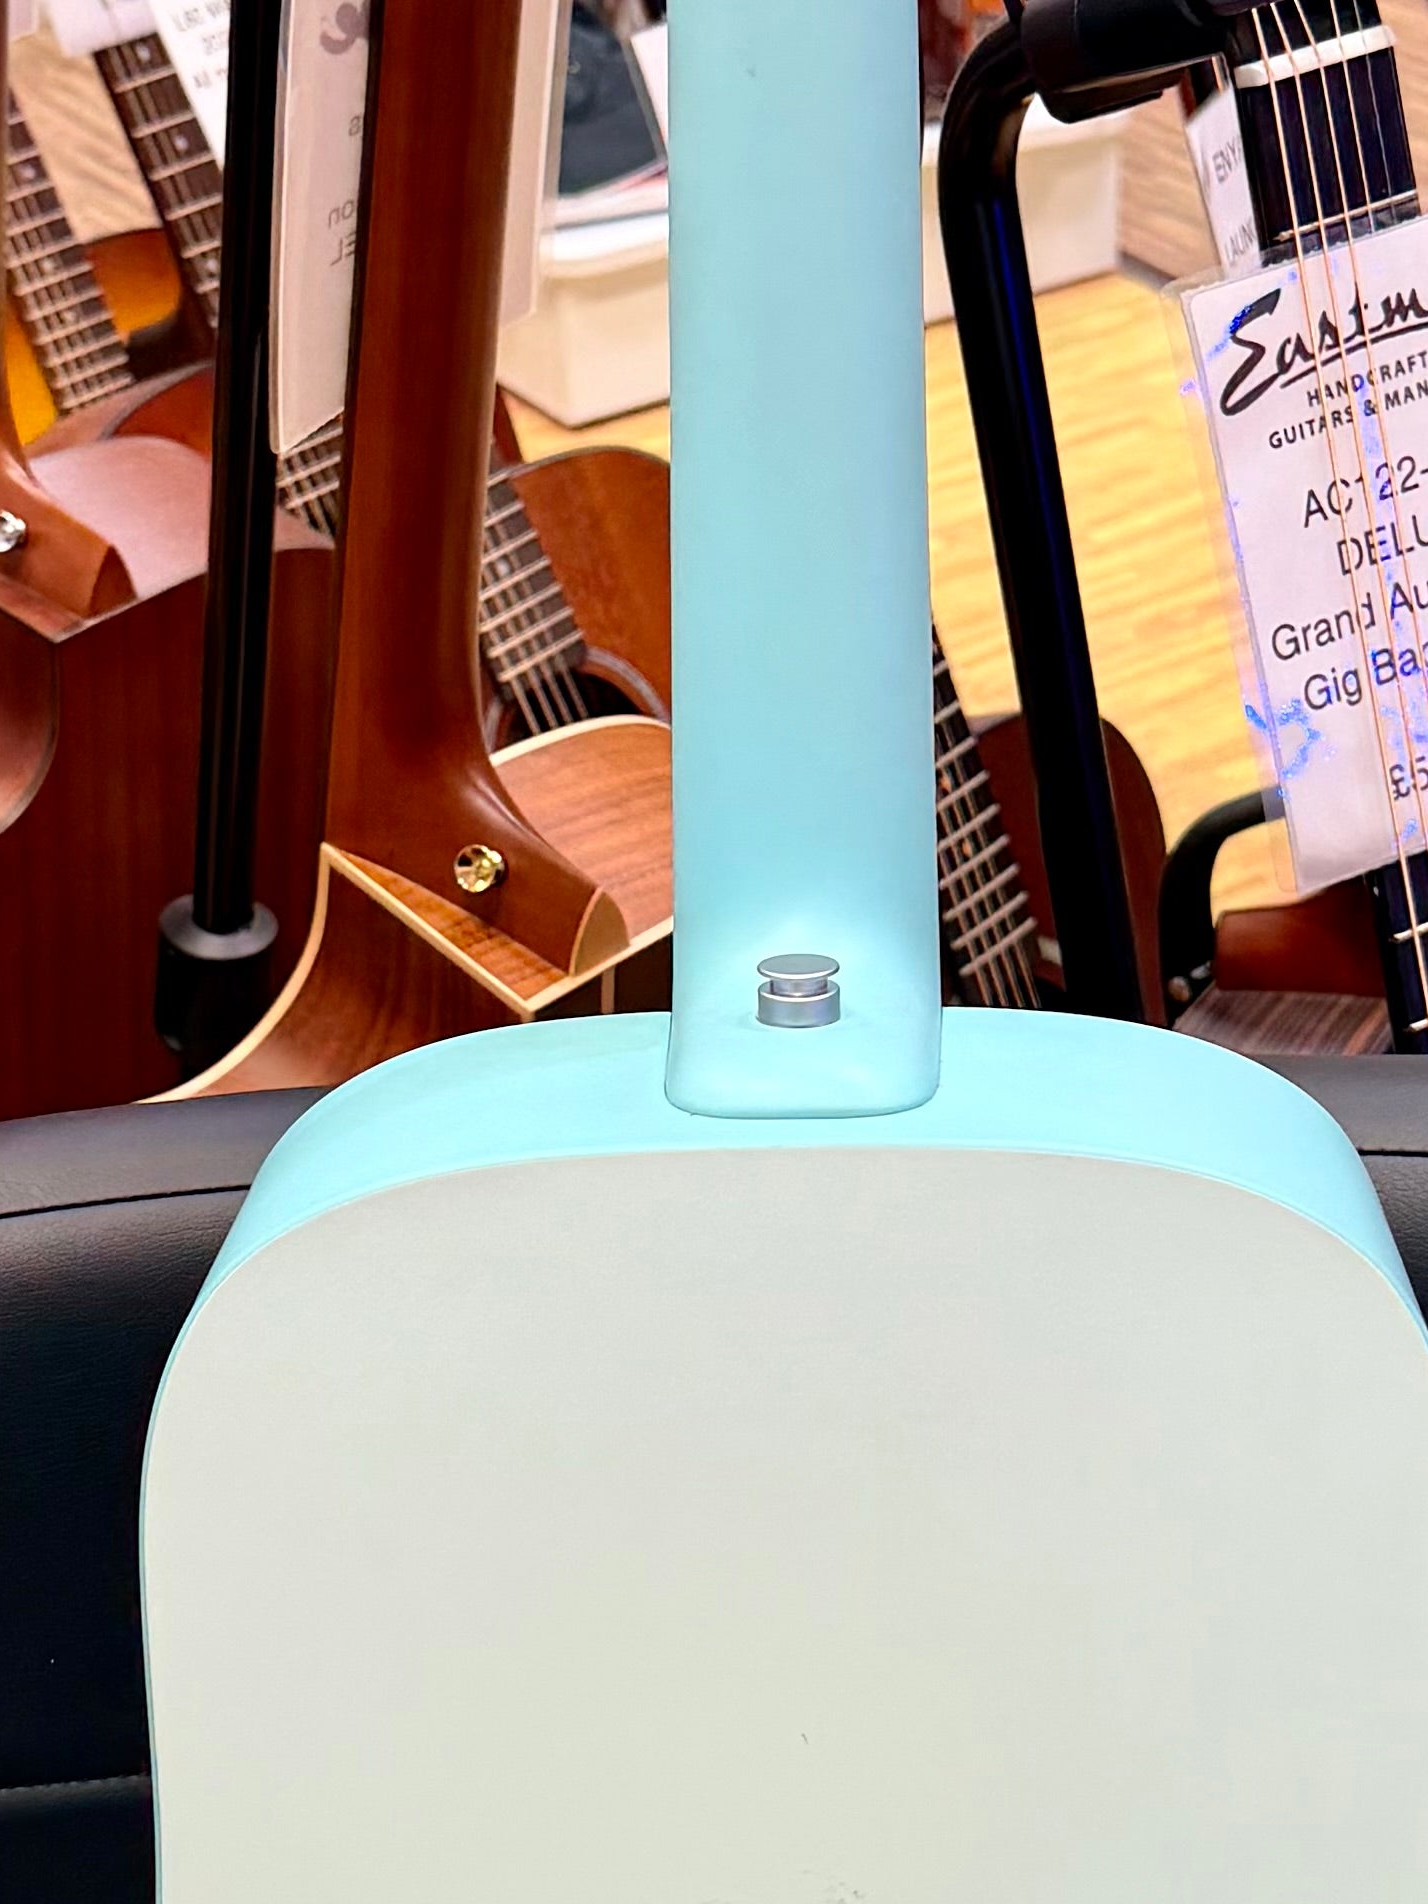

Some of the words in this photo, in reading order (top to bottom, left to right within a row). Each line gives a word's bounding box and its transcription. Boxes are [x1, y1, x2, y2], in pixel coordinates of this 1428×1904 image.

[1212, 135, 1242, 183] ENY
[1269, 405, 1353, 449] GUITARS
[1272, 593, 1375, 661] Grand
[1304, 668, 1362, 711] Gig
